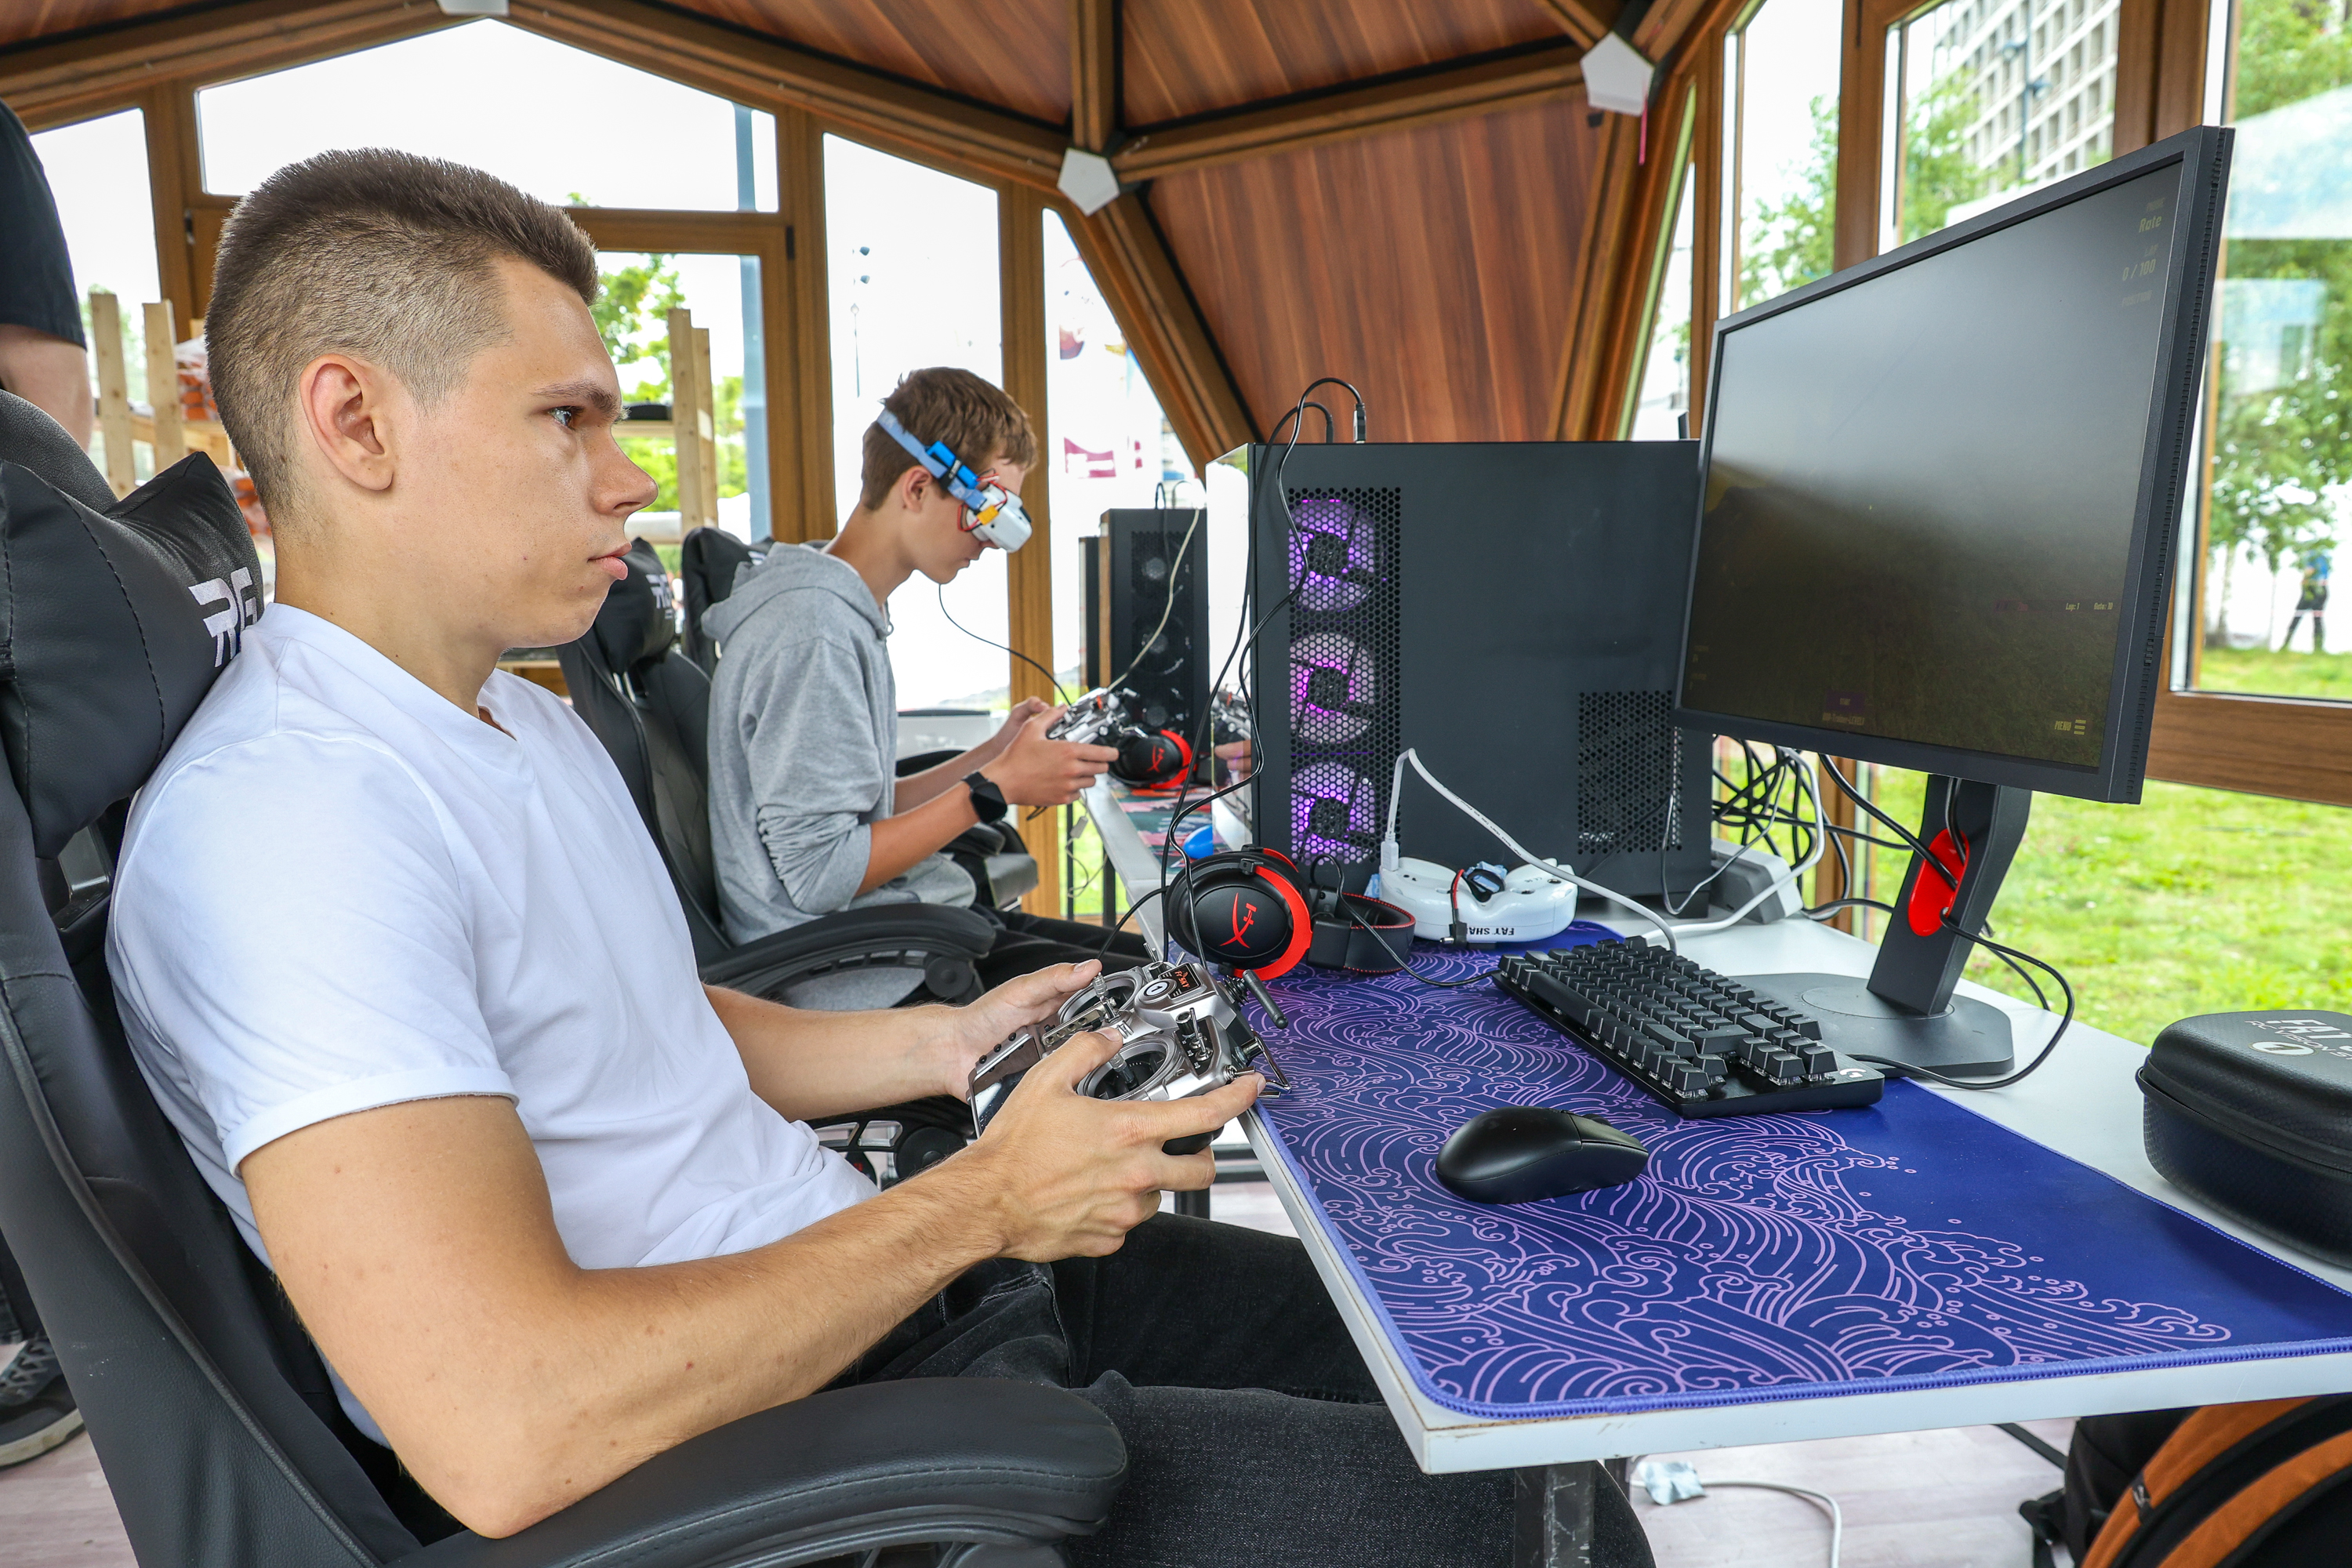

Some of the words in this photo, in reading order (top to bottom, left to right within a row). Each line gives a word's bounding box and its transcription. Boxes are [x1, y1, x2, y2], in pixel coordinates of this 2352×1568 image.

[2139, 216, 2162, 233] Rate
[2122, 267, 2129, 281] 0
[2140, 259, 2157, 277] 100
[2054, 720, 2072, 731] MENU
[2244, 1020, 2278, 1030] RC
[2274, 1030, 2336, 1051] VISION
